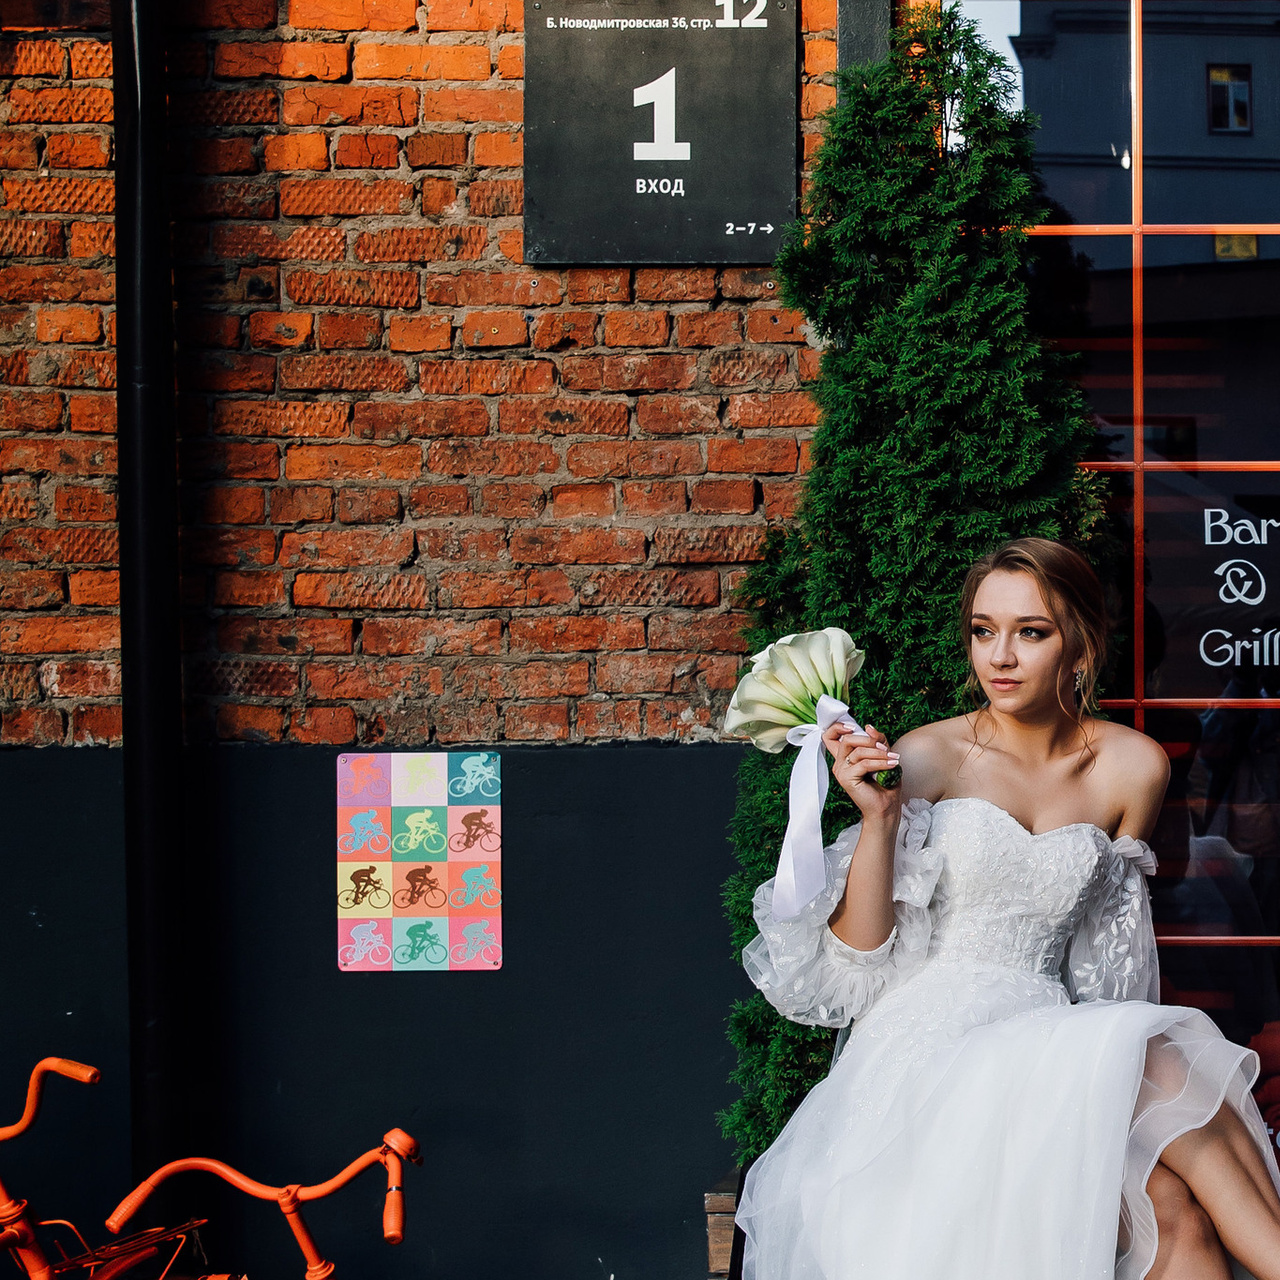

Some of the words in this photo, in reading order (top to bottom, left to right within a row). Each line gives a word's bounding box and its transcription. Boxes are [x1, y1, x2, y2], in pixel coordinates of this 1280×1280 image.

[546, 16, 558, 29] Б.
[559, 16, 670, 32] Новодмитровская
[671, 16, 689, 31] 36,
[690, 18, 714, 32] стр.
[633, 66, 691, 161] 1
[635, 178, 685, 197] ВХОД
[1213, 558, 1267, 606] &
